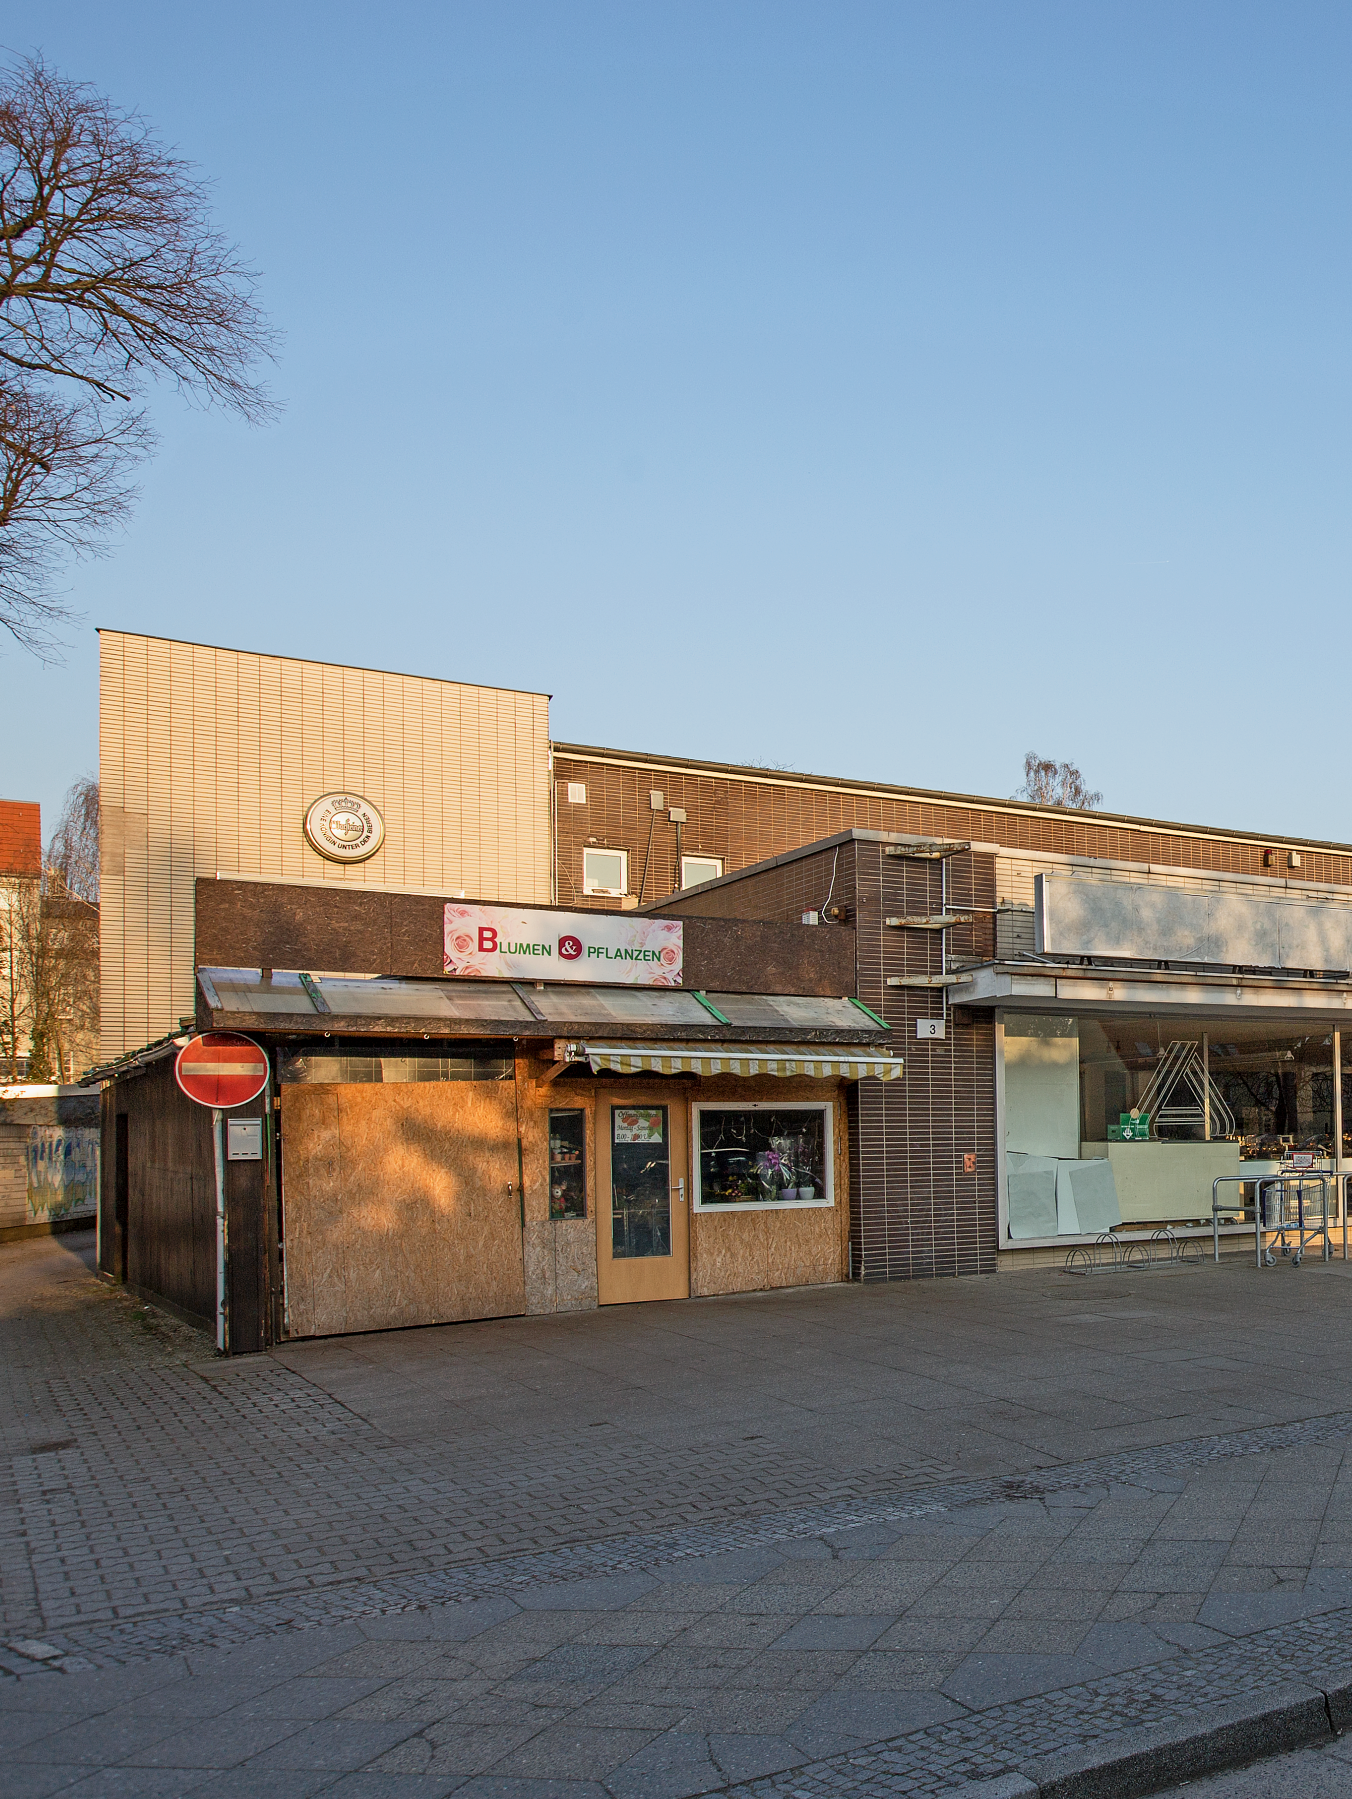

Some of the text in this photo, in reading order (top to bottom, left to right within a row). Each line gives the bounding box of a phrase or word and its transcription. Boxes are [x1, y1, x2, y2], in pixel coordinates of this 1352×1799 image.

[337, 842, 360, 850] UNTER
[360, 834, 372, 846] DEN
[561, 940, 578, 956] &
[587, 946, 662, 962] PFLANZEN
[929, 1024, 936, 1035] 3
